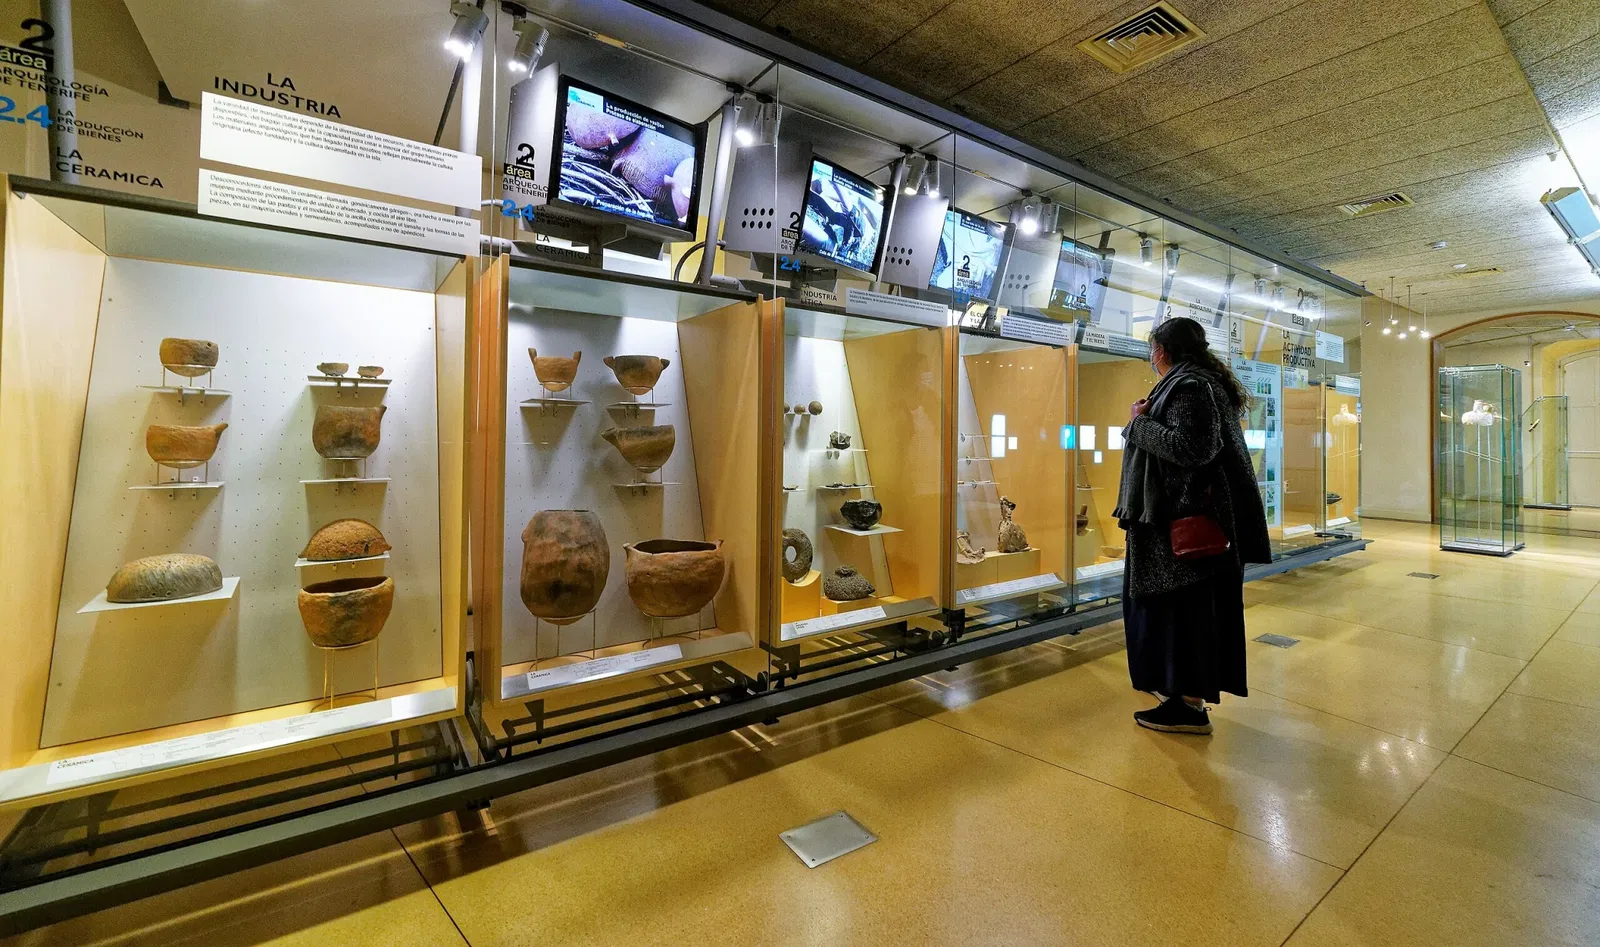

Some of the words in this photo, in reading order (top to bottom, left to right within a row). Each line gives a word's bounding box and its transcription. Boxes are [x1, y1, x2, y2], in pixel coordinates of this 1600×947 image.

[19, 18, 55, 52] 2
[0, 48, 48, 71] área
[267, 72, 296, 91] LA
[18, 79, 91, 103] TENERIFE
[214, 76, 342, 119] INDUSTRIA
[57, 108, 75, 118] LA
[57, 117, 144, 140] PRODUCCIÓN
[57, 125, 75, 135] DE
[78, 129, 122, 143] BIENES
[299, 117, 323, 128] depende
[339, 127, 365, 137] diversidad
[304, 140, 322, 148] cultura
[324, 143, 356, 155] desarrollada
[323, 131, 350, 140] capacidad
[382, 143, 400, 152] innovar
[56, 147, 83, 161] LA
[323, 137, 342, 146] llegado
[343, 141, 358, 149] hasta
[359, 146, 380, 154] nosotros
[400, 155, 430, 165] parcialmente
[516, 143, 535, 168] 2
[506, 165, 532, 180] área
[503, 184, 514, 192] DE
[265, 192, 307, 203] procedimientos
[276, 208, 297, 216] ovoides
[309, 207, 335, 215] modelado
[367, 217, 396, 226] condicionan
[434, 227, 450, 235] formas
[790, 211, 801, 230] 2
[536, 233, 550, 243] LA
[963, 255, 970, 270] 2
[1081, 284, 1086, 297] 2
[1232, 322, 1237, 332] 2
[1283, 330, 1290, 340] LA
[1283, 342, 1311, 356] ACTIVIDAD
[1283, 354, 1316, 369] PRODUCTIVA
